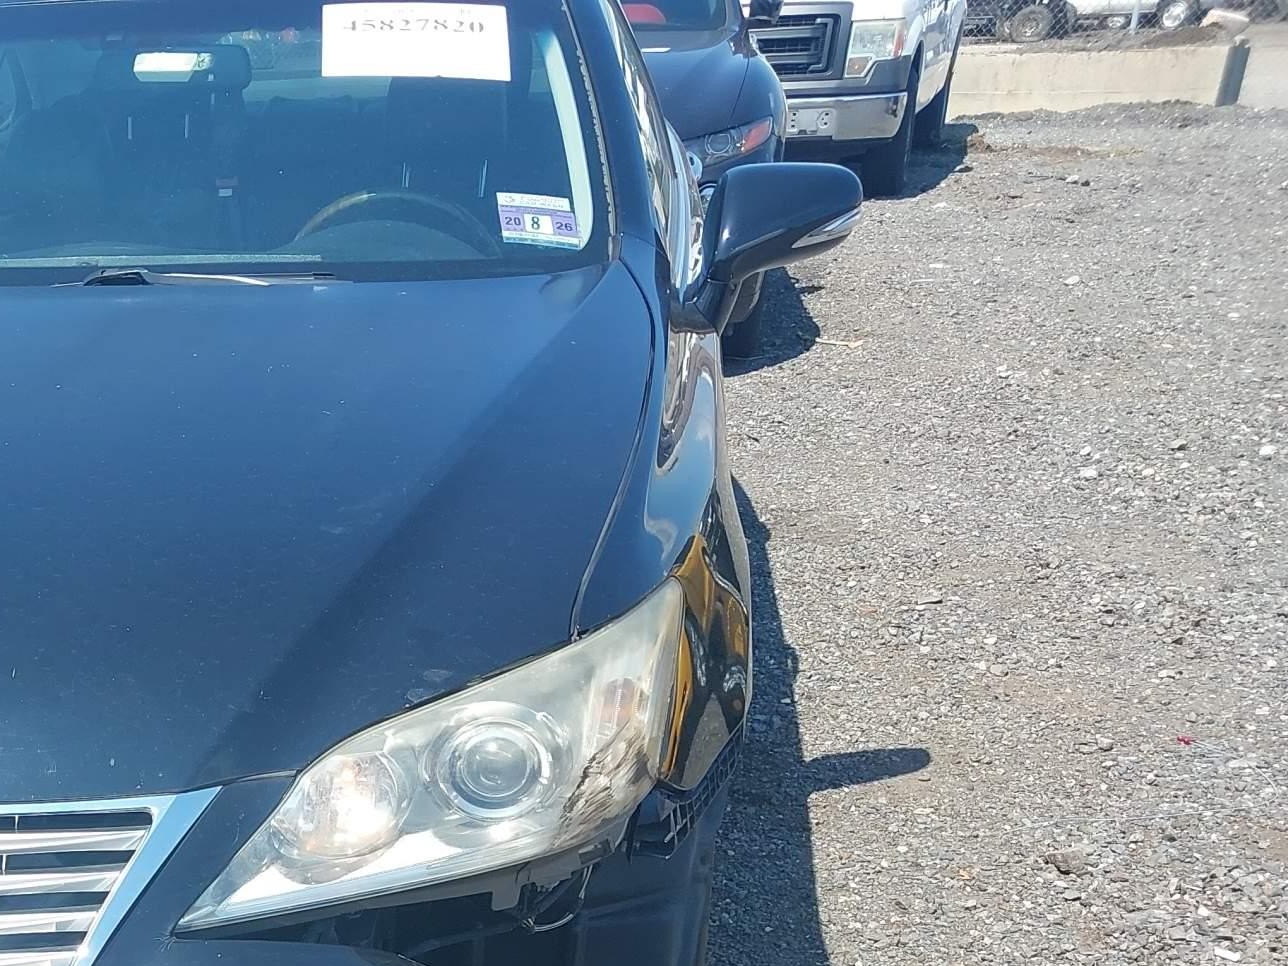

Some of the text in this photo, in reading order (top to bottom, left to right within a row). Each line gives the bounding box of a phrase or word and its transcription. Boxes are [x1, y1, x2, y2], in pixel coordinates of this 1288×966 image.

[343, 18, 484, 33] 45827820
[505, 216, 573, 232] 20 8 26
